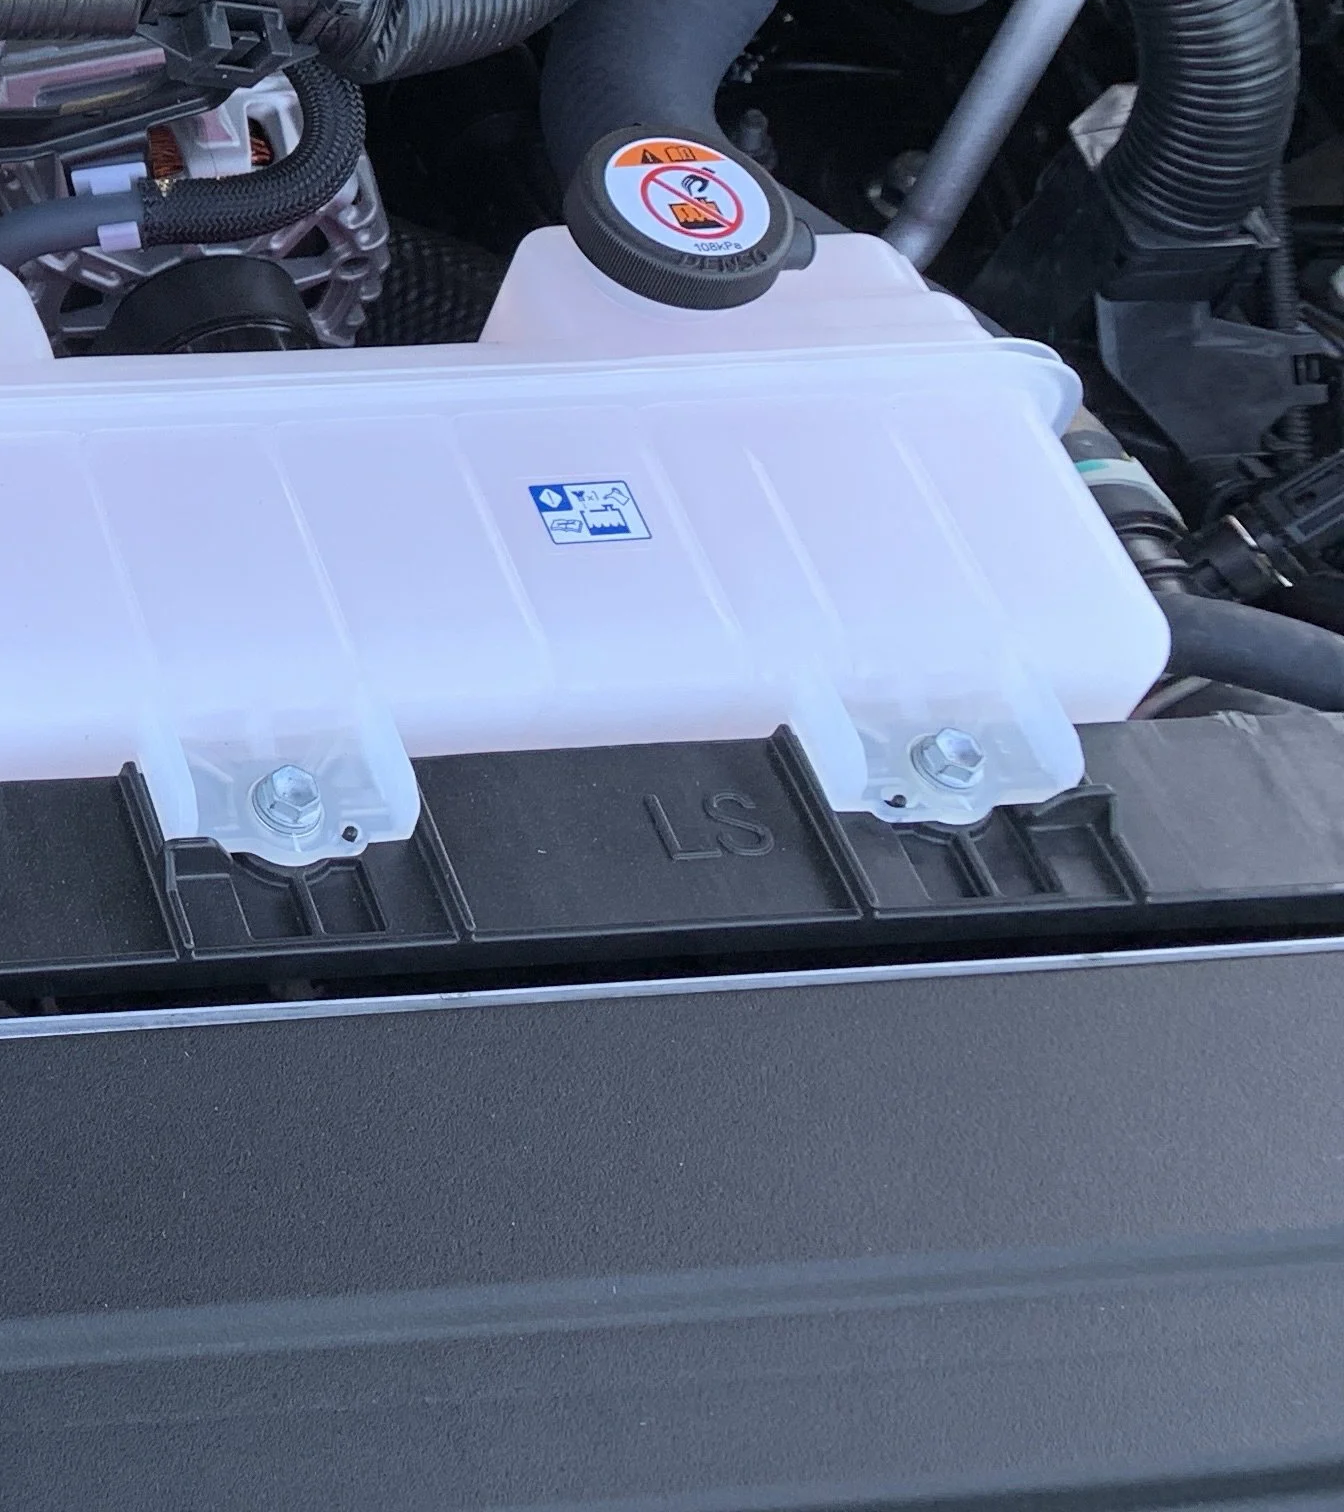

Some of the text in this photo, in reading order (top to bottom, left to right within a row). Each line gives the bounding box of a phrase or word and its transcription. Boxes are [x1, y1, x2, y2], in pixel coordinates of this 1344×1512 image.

[693, 241, 743, 252] 108kPa
[681, 248, 768, 272] DENSO
[643, 790, 775, 862] LS
